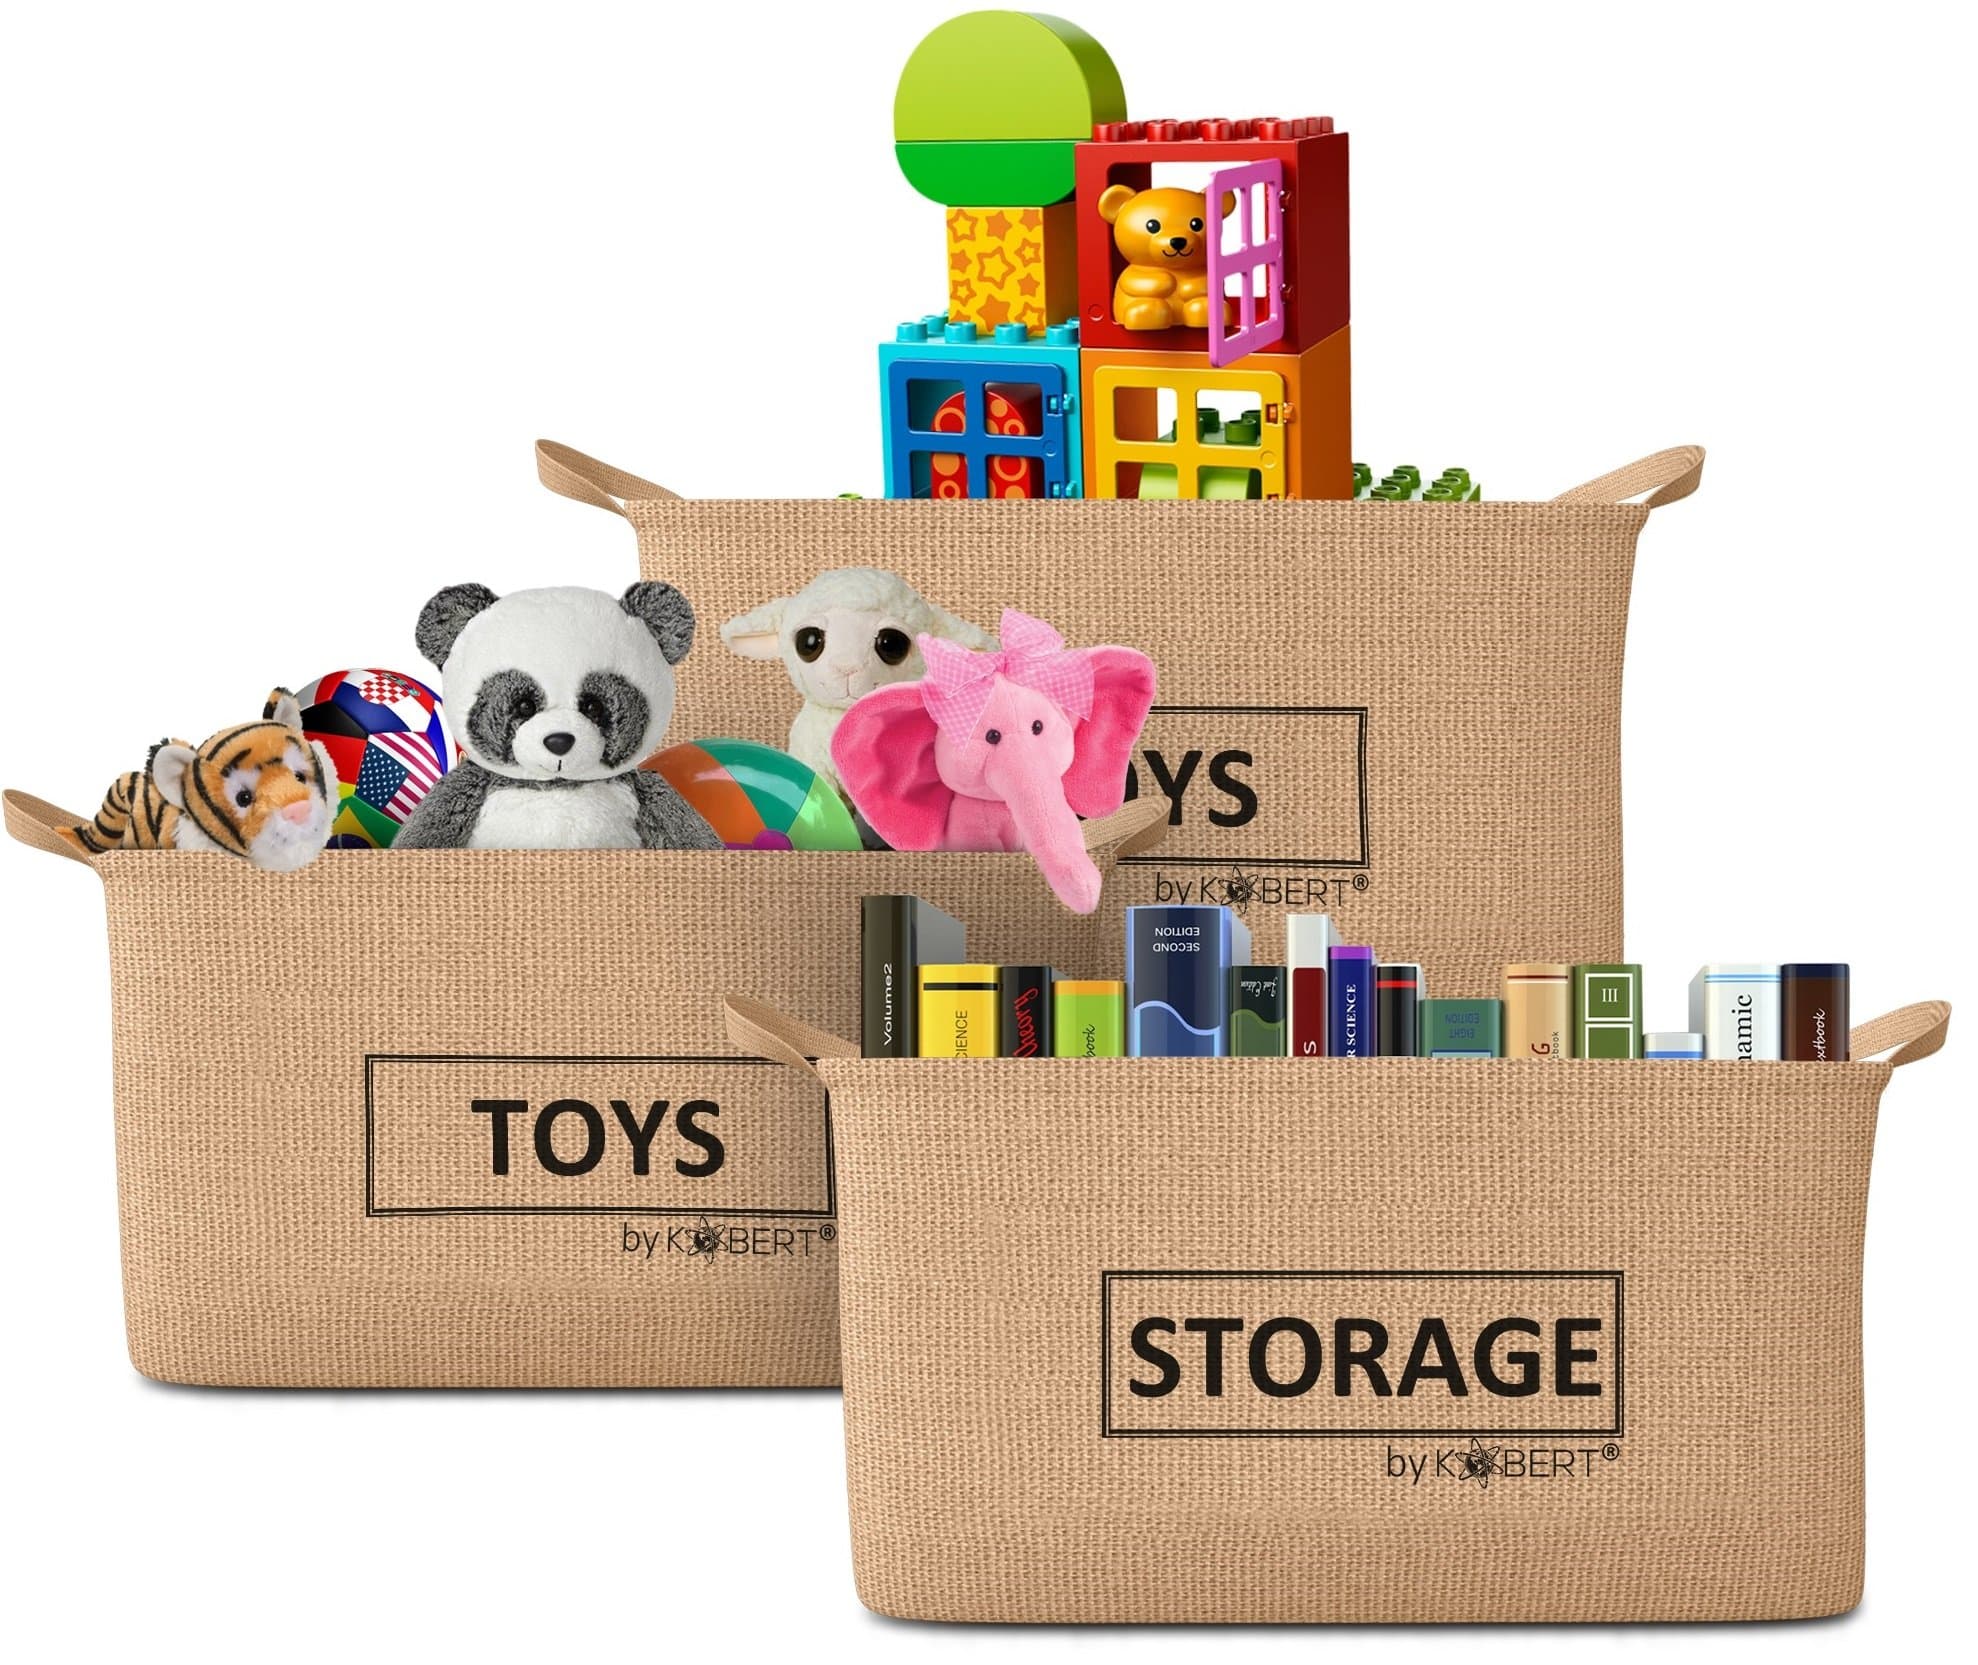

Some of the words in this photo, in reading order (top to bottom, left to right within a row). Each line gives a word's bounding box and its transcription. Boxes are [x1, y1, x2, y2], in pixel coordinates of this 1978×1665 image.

[1124, 749, 1258, 828] YS
[1155, 872, 1192, 905] by
[1152, 942, 1200, 952] SECOND
[1154, 926, 1200, 937] EDITION
[883, 962, 893, 1046] Volume2
[1347, 984, 1357, 1047] SCIENCE
[1812, 1008, 1826, 1061] xtbook
[471, 1098, 726, 1178] TOYS
[622, 1222, 659, 1259] by
[1129, 1316, 1602, 1398] STORAGE
[1387, 1445, 1427, 1486] by
